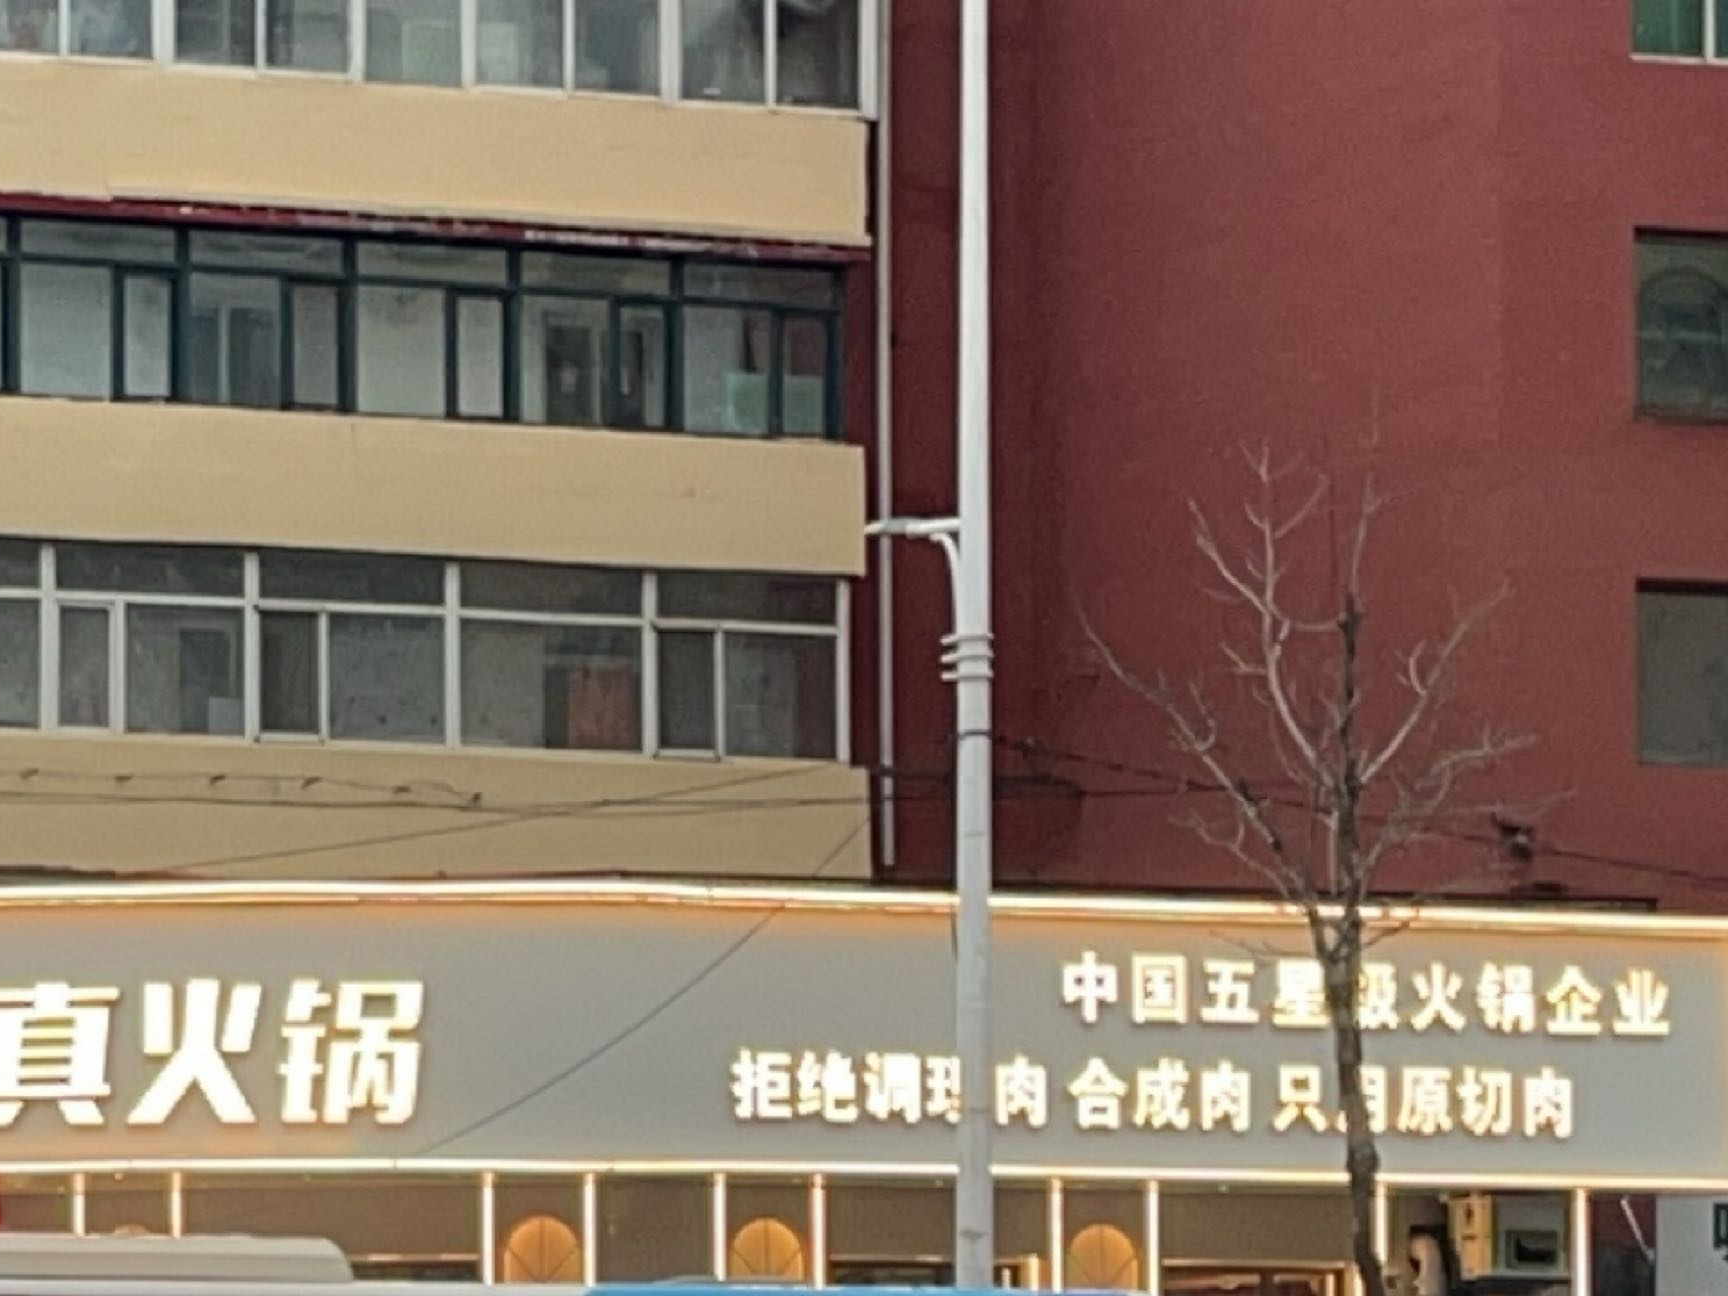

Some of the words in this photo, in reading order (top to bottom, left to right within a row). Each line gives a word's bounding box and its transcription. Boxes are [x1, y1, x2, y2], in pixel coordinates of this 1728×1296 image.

[1060, 950, 1672, 1037] 中国五星级火锅企业
[1067, 1057, 1252, 1131] 合成肉
